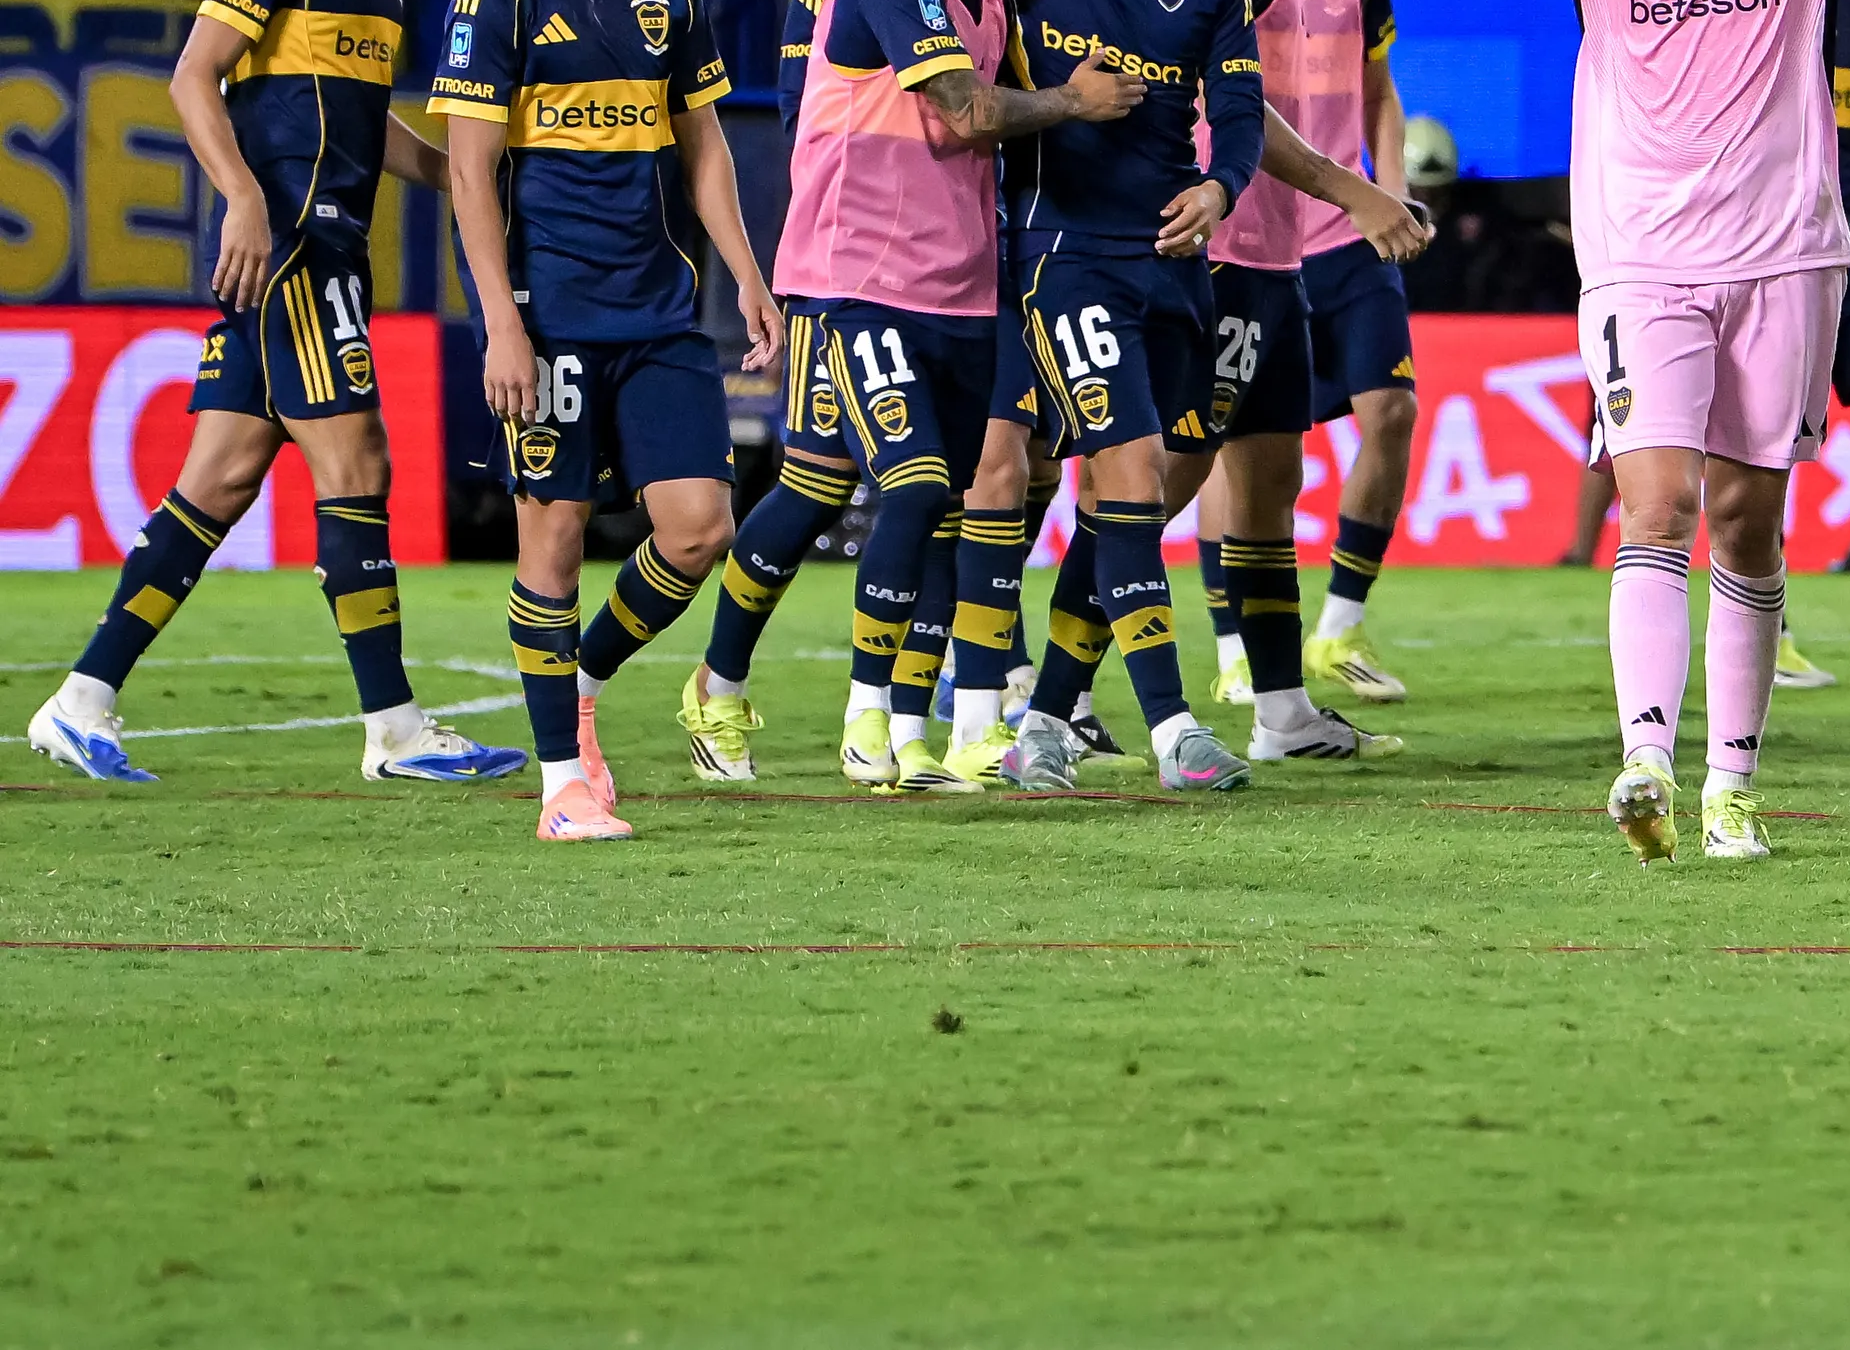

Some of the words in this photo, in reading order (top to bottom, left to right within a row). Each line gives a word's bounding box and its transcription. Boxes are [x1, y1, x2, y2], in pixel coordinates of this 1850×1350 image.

[852, 326, 917, 395] 11
[1055, 304, 1123, 380] 16
[1218, 316, 1263, 382] 26
[1602, 313, 1626, 383] 1
